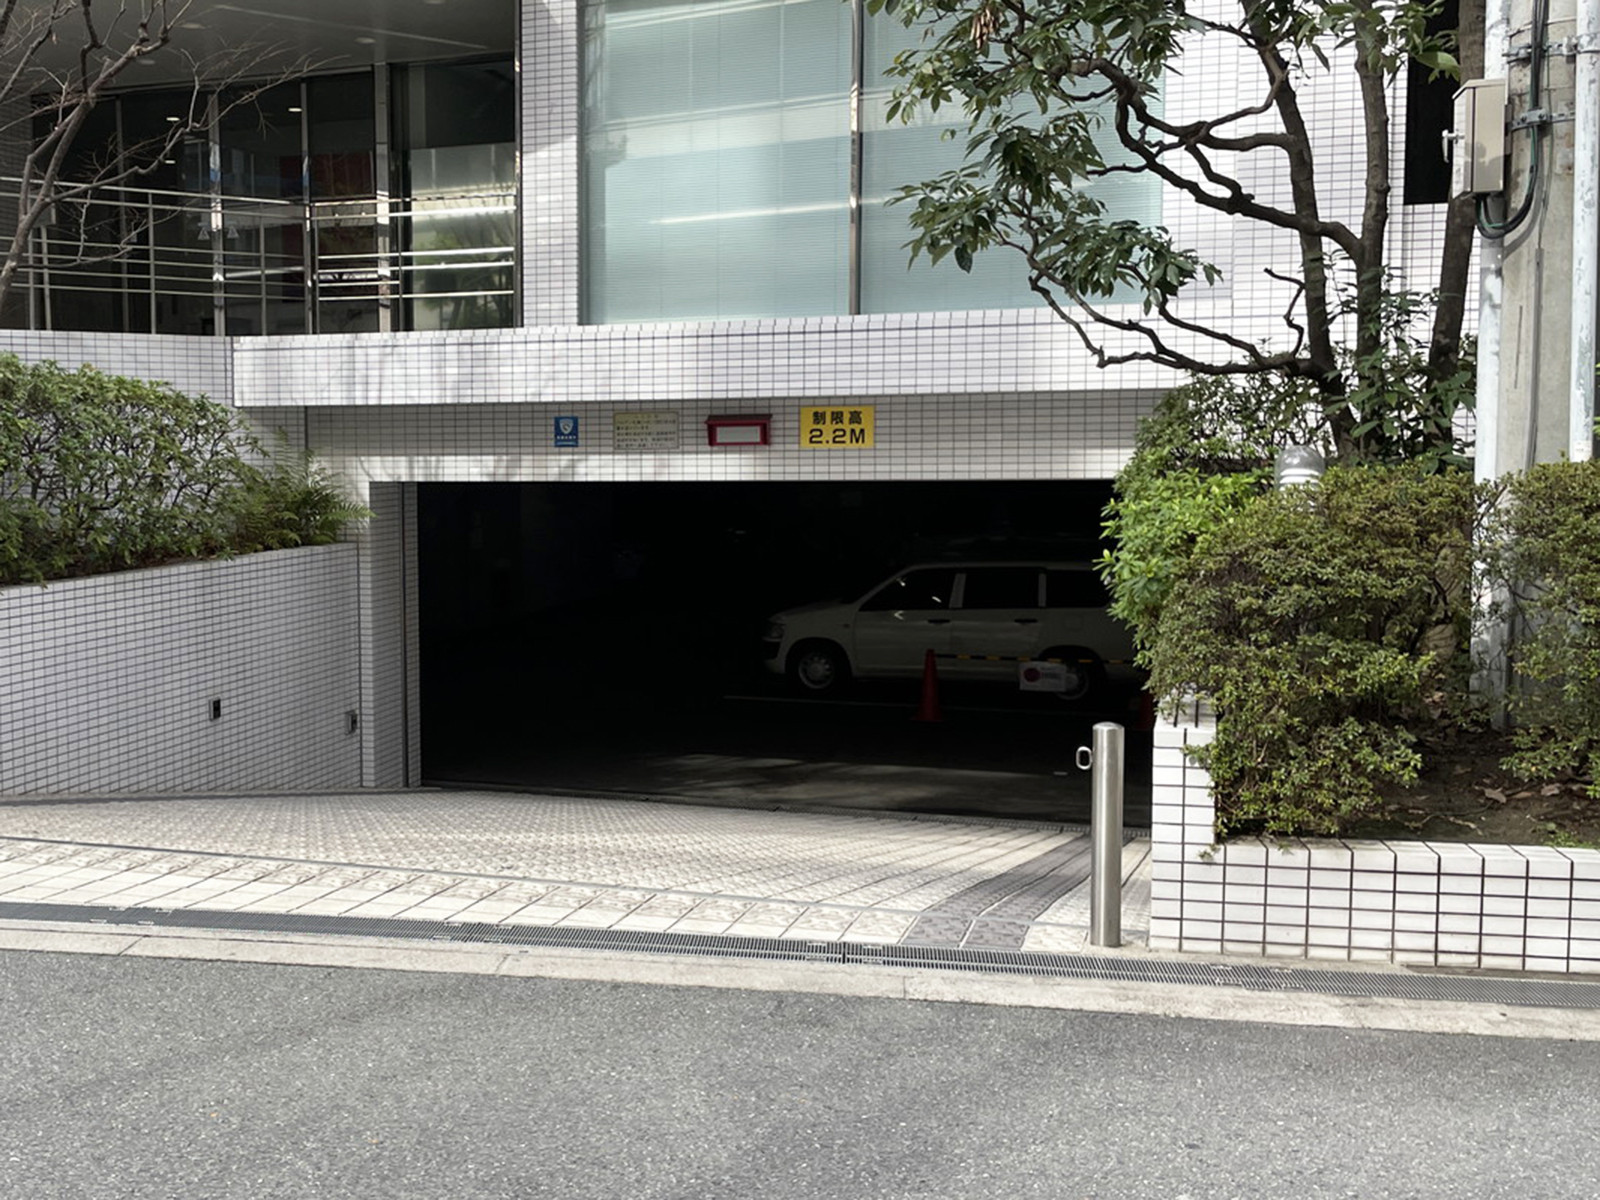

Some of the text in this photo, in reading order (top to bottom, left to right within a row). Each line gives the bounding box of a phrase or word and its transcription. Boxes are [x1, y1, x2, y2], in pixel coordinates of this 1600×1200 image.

[813, 411, 862, 425] 制限高
[809, 428, 865, 444] 2.2M
